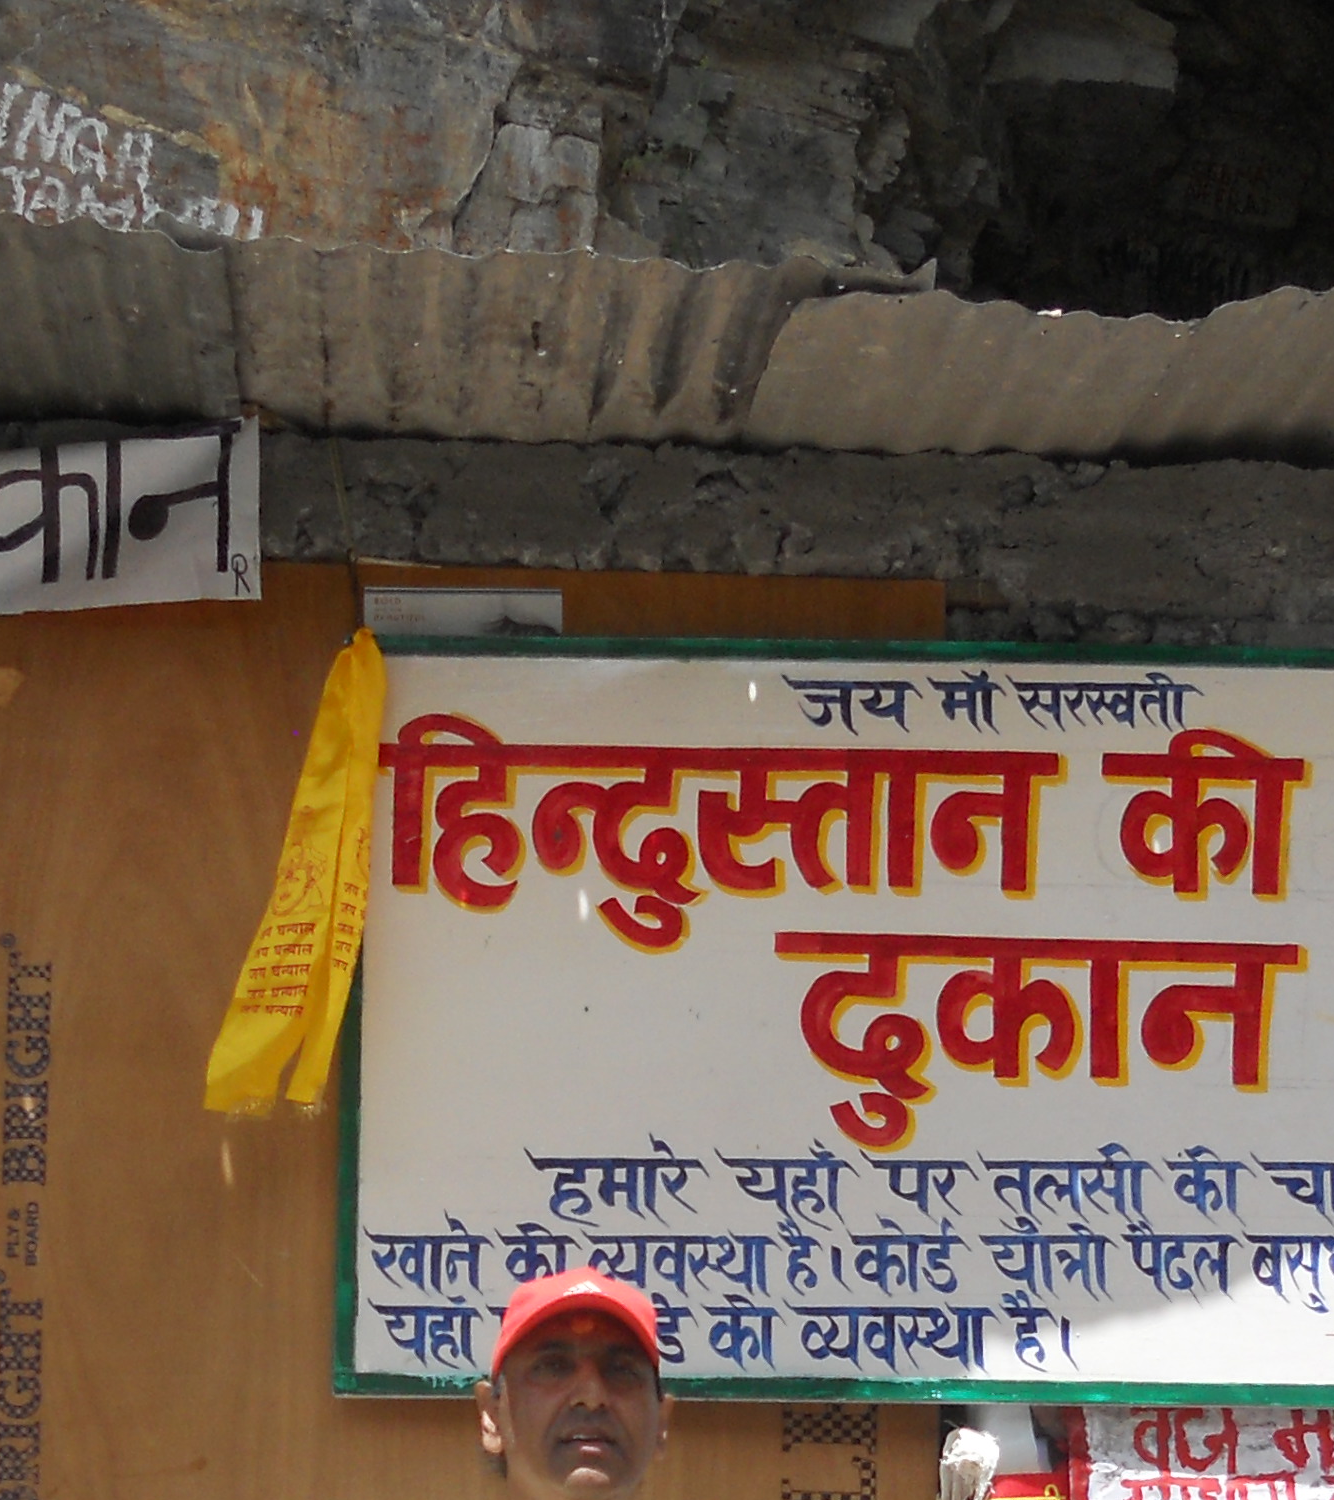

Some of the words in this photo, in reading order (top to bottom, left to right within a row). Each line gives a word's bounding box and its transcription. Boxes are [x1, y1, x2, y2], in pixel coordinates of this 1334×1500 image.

[782, 674, 923, 735] जय
[1006, 672, 1205, 732] सरस्वती
[379, 713, 1069, 952] हिन्दुस्तान
[1102, 728, 1314, 904] की
[774, 932, 1309, 1152] दुकान
[524, 1133, 710, 1227] हमारे
[866, 1149, 978, 1217] पर
[976, 1142, 1164, 1234] तुलसी
[367, 1210, 493, 1296] खाने
[582, 1230, 788, 1297] व्यवस्था
[848, 1213, 971, 1297] कोई
[1120, 1219, 1245, 1307] पैदल
[703, 1294, 787, 1372] की
[786, 1300, 1007, 1372] व्यवस्था
